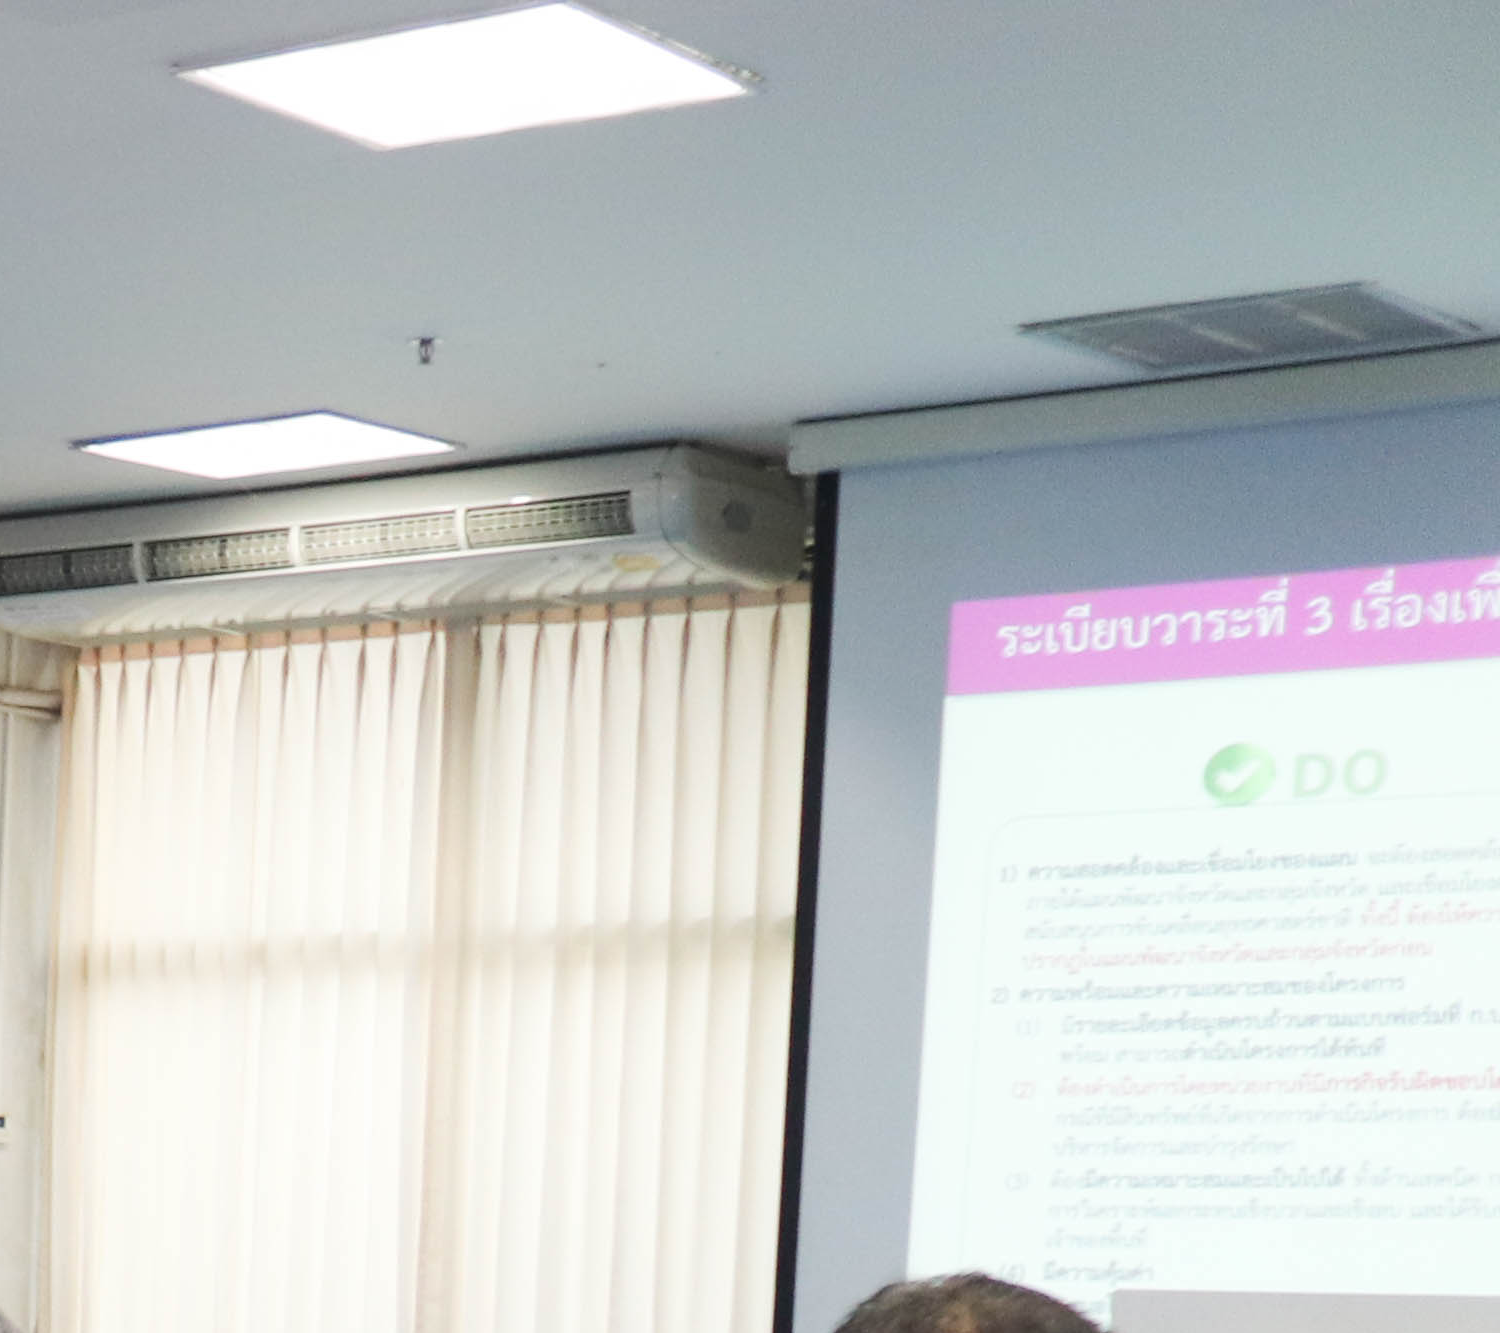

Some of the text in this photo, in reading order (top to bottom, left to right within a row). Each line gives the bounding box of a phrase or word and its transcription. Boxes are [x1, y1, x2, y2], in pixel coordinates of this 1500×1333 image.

[996, 579, 1288, 659] ระเบียบวาระที่
[1304, 599, 1332, 636] 3
[1292, 748, 1390, 798] DO
